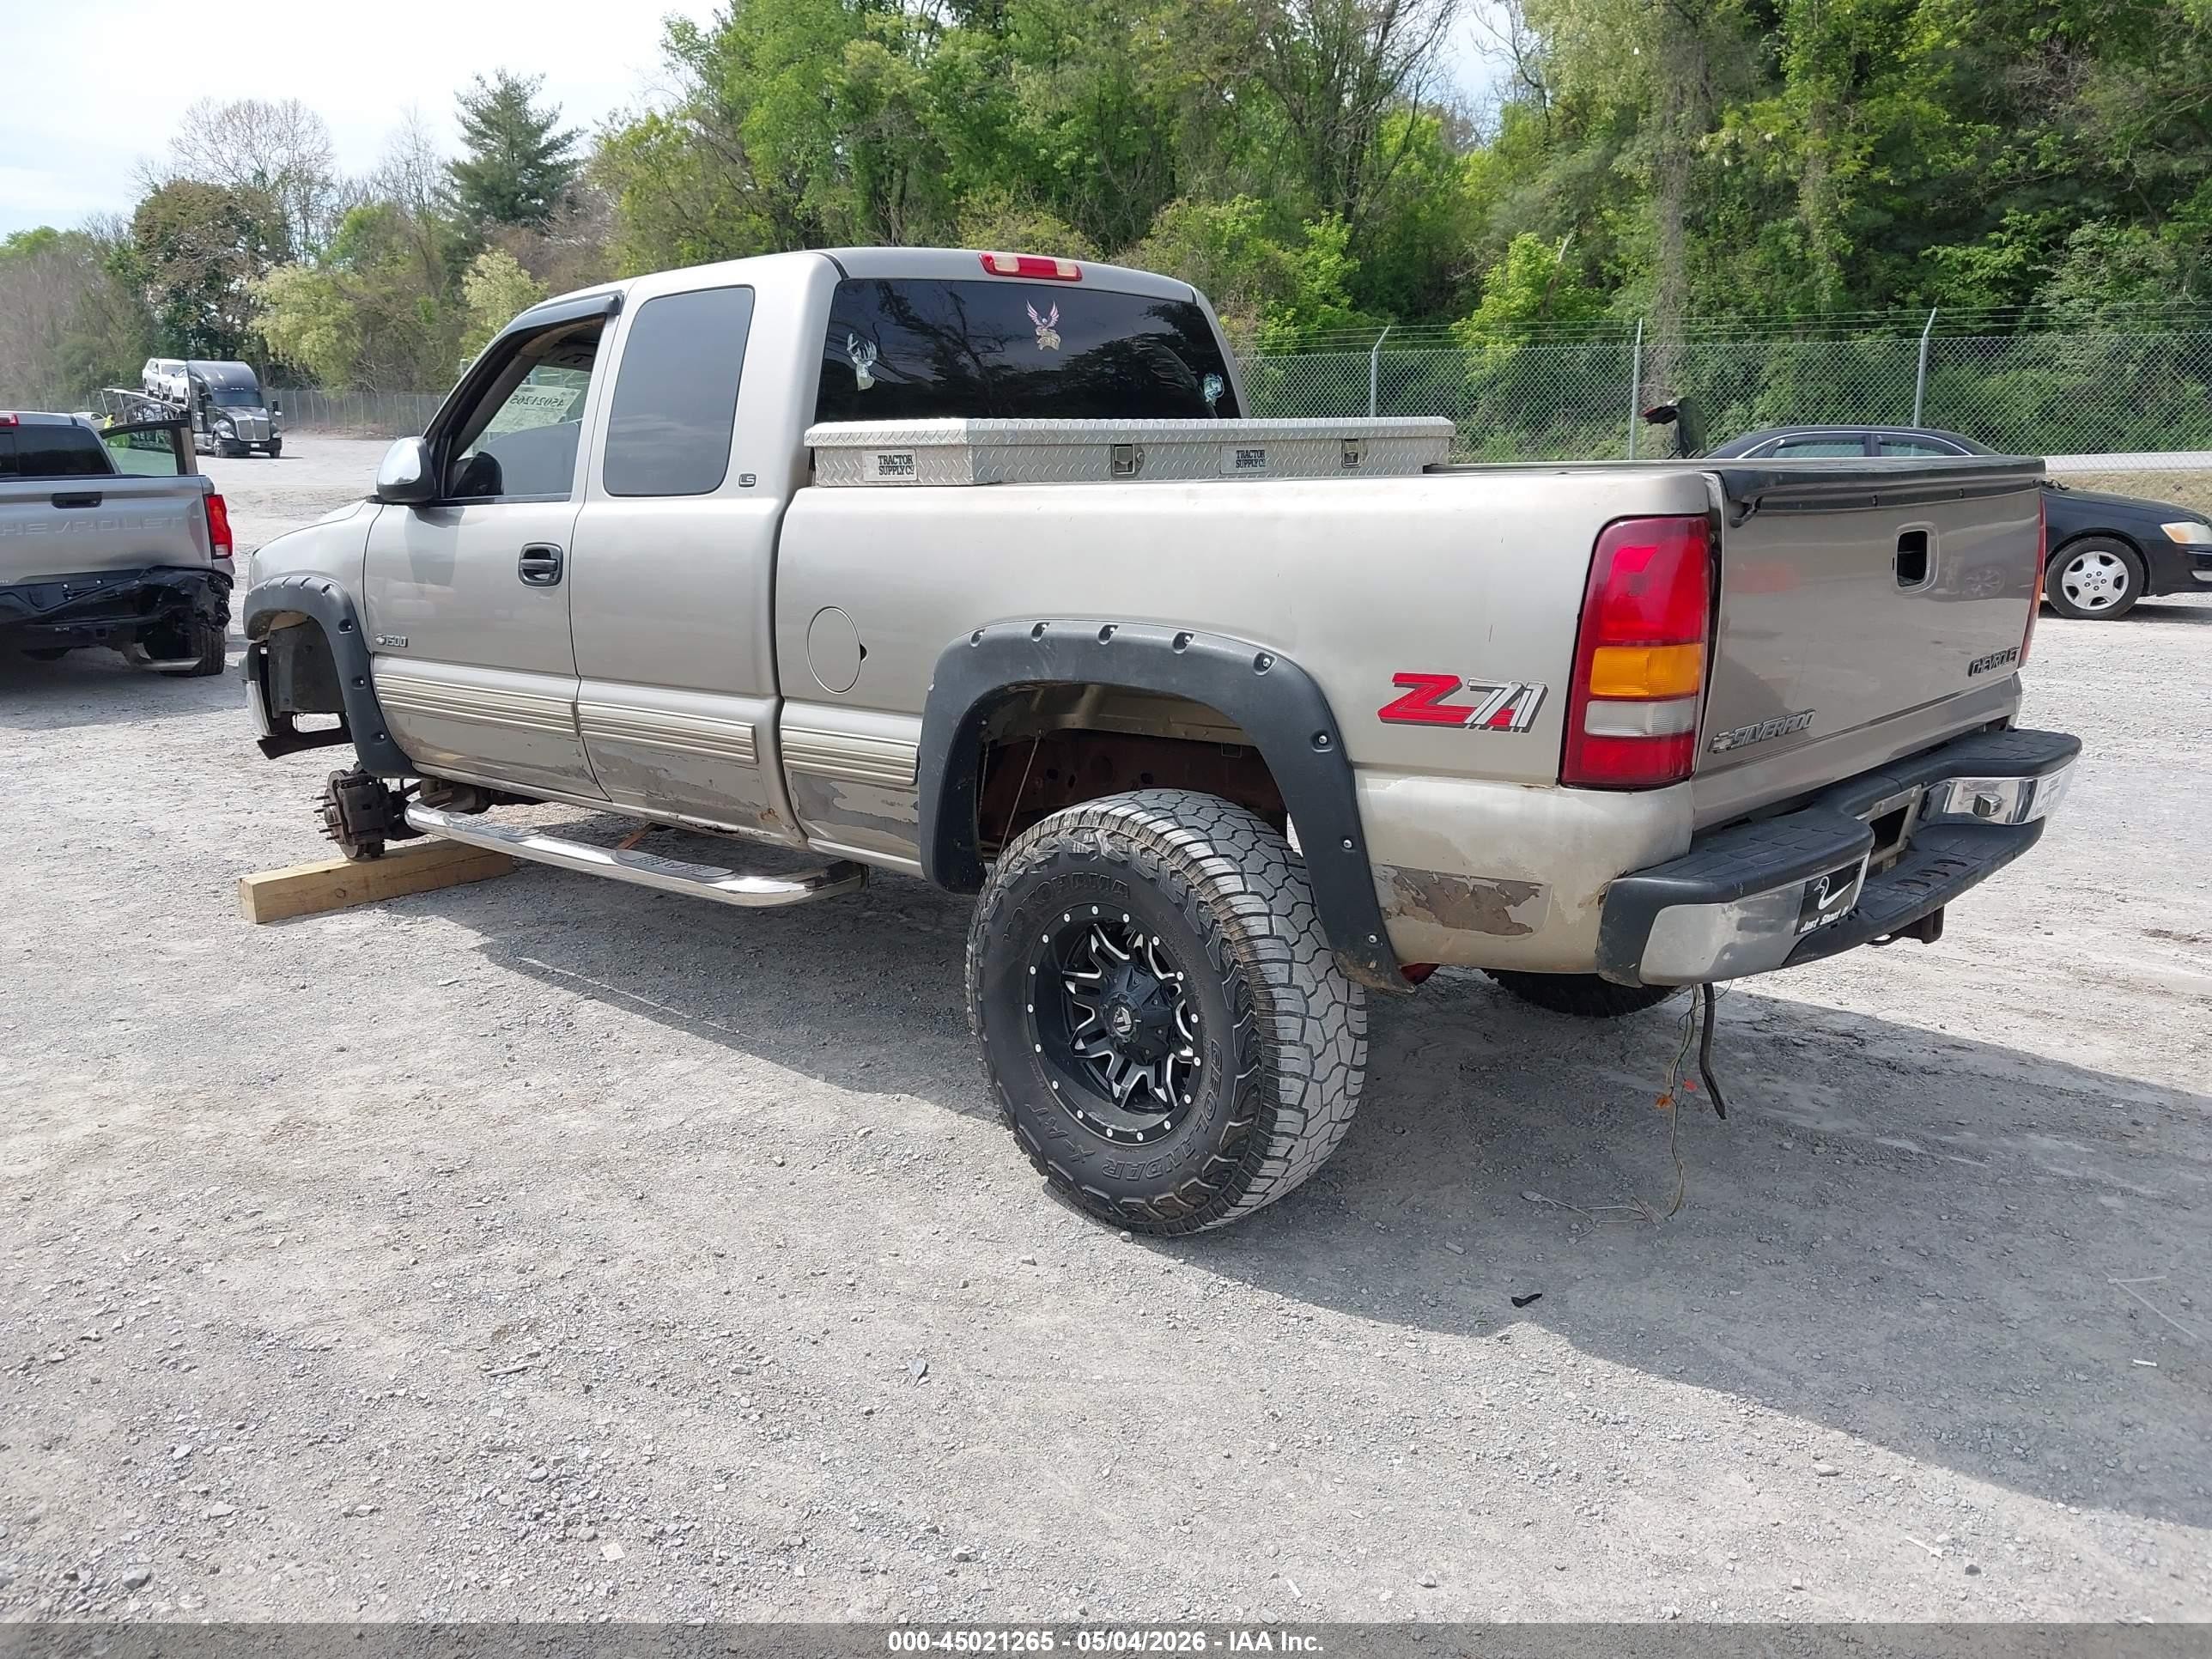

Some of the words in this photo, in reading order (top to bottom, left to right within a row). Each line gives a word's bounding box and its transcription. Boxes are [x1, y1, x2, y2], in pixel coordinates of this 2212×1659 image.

[878, 454, 914, 465] TRACTOR
[1236, 449, 1266, 459] TRACTOR
[878, 465, 905, 476] SUPPLY
[1236, 459, 1258, 468] SUPPLY
[738, 473, 757, 487] LS
[0, 515, 183, 536] HEVROLET
[1967, 647, 2021, 677] CHEVROLET
[1377, 673, 1548, 732] Z71
[1730, 708, 1816, 750] SILVERADO
